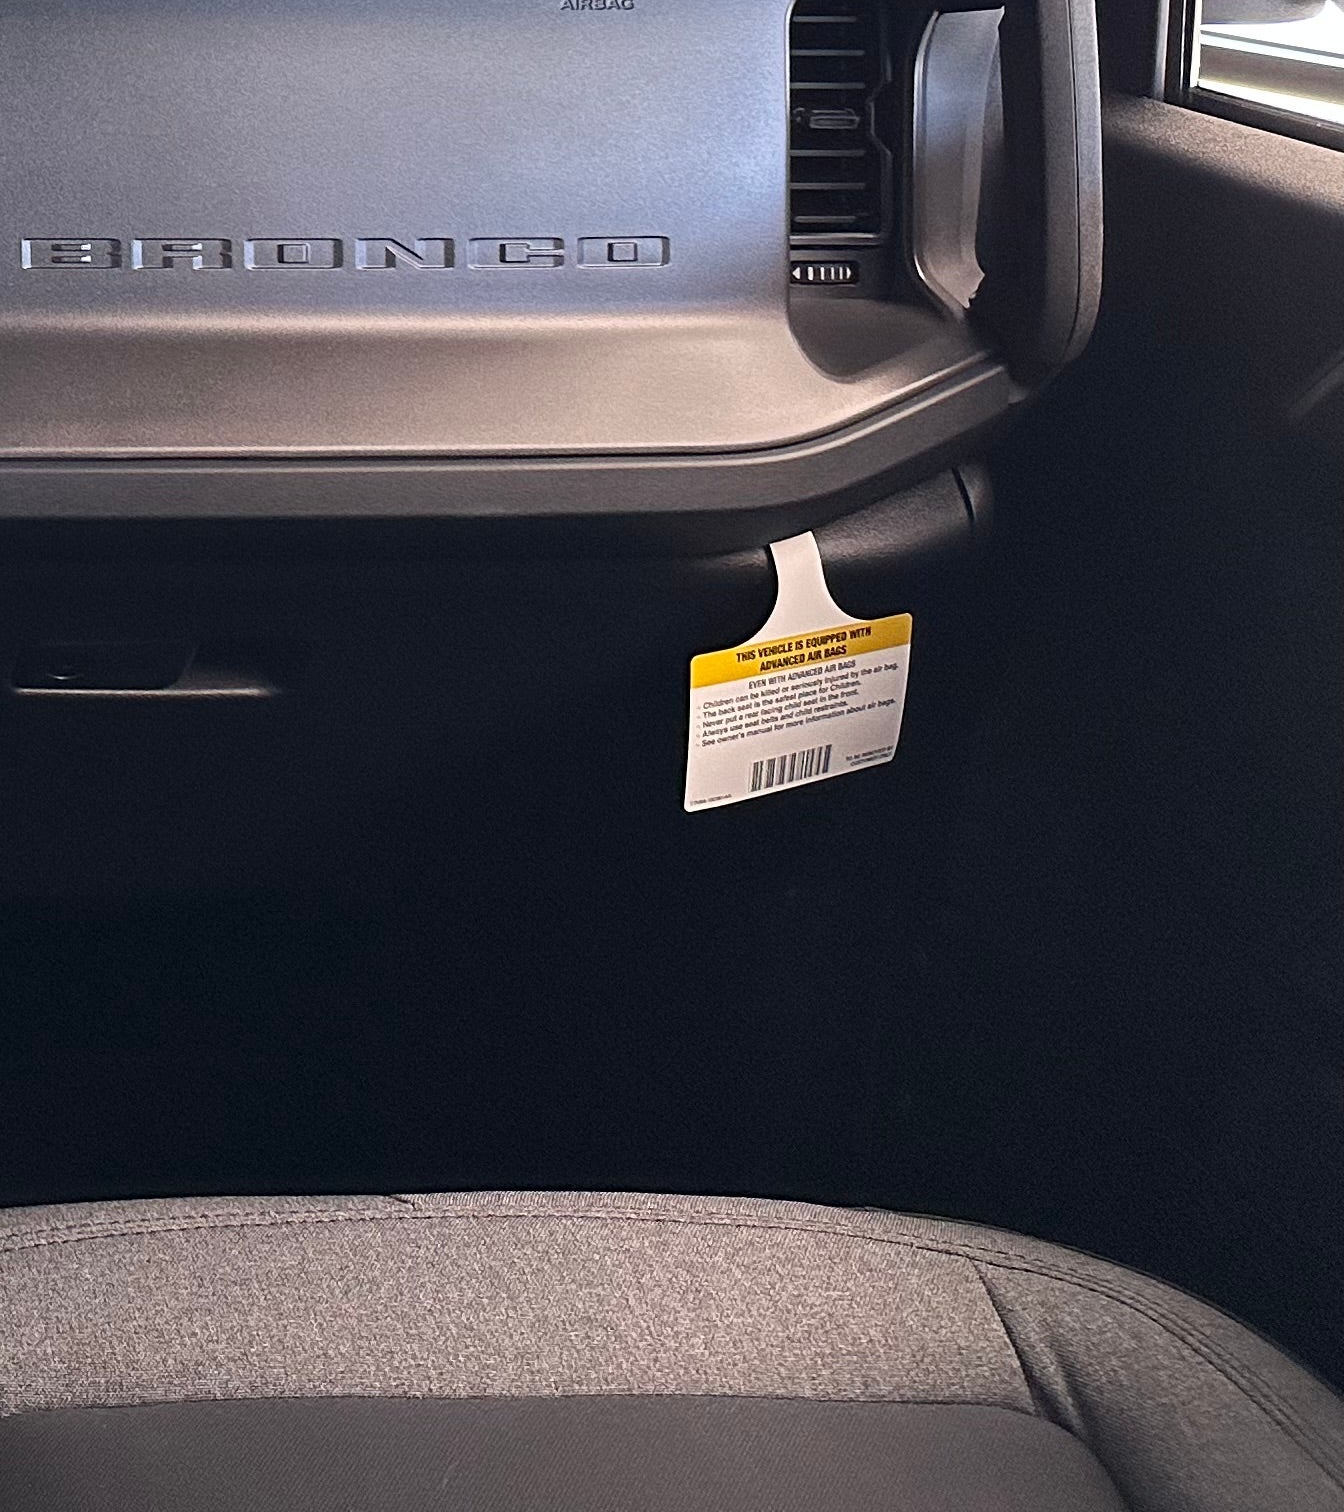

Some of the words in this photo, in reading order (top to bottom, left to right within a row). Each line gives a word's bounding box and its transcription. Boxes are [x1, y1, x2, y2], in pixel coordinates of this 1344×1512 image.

[20, 235, 671, 271] BRONCO
[736, 649, 756, 663] THIS
[758, 641, 793, 658] VEHICLE
[795, 640, 803, 651] IS
[806, 631, 847, 648] EQUIPPED
[849, 626, 872, 639] WITH
[760, 653, 805, 672] ADVANCED
[807, 650, 822, 662] AIR
[824, 645, 847, 658] BAGS
